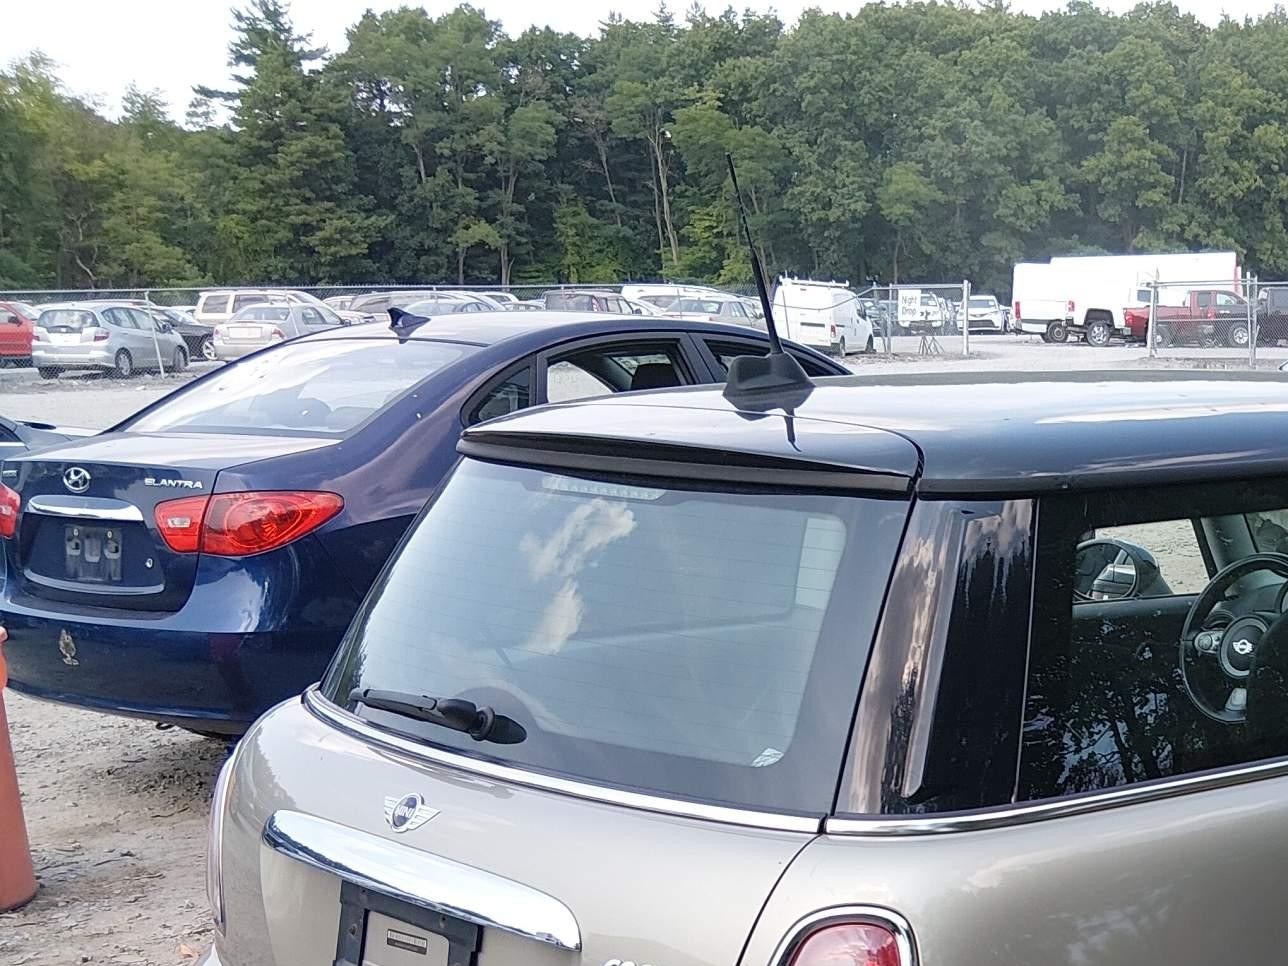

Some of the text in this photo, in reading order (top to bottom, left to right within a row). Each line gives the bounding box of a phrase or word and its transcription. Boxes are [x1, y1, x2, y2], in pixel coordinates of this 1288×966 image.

[902, 296, 917, 306] Night
[902, 307, 917, 316] Drop
[144, 477, 203, 489] ELANTRA
